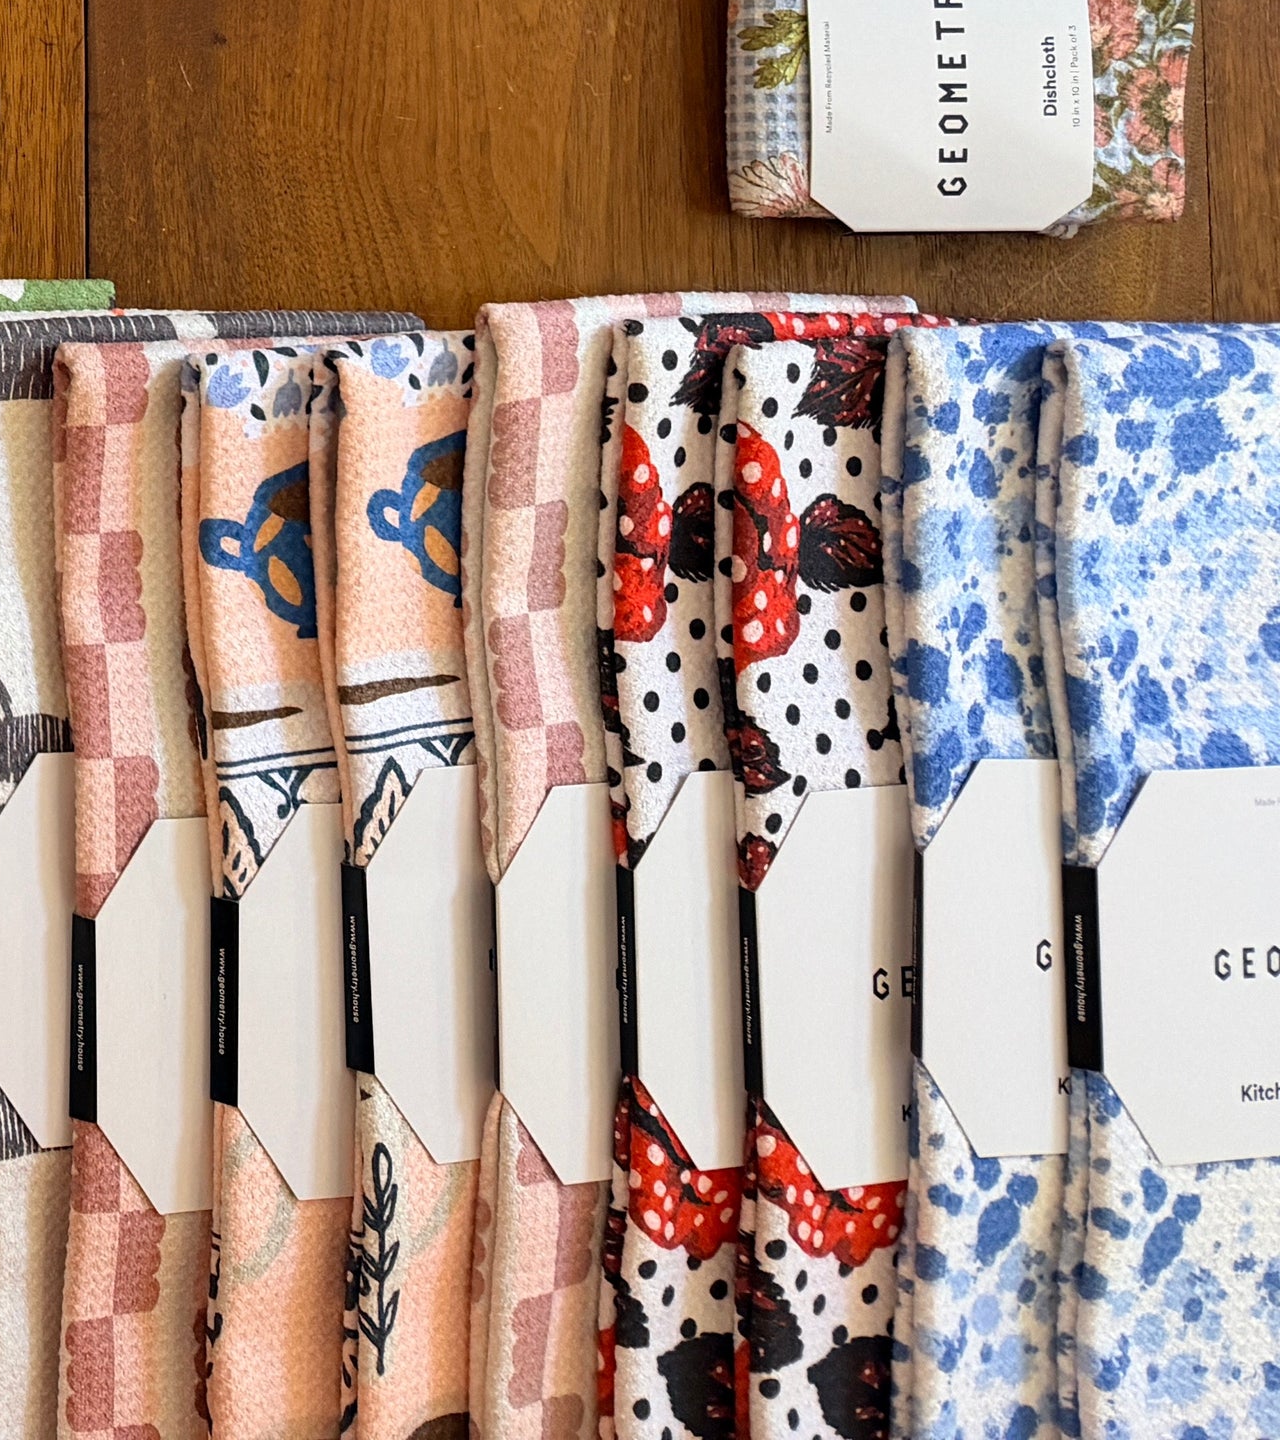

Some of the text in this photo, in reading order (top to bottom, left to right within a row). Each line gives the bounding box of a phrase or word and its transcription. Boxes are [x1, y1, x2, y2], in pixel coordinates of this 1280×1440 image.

[1068, 33, 1077, 43] of
[1069, 45, 1079, 68] Pack
[1040, 36, 1057, 116] Dishcloth
[1071, 75, 1079, 84] in
[1071, 85, 1080, 96] 10
[1071, 106, 1080, 115] in
[1071, 117, 1081, 128] 10
[349, 915, 360, 1023] www.geometry.house
[1073, 914, 1087, 1022] www.geometry.house
[217, 947, 227, 1055] www.geometry.house
[76, 964, 85, 1071] www.geometry.house
